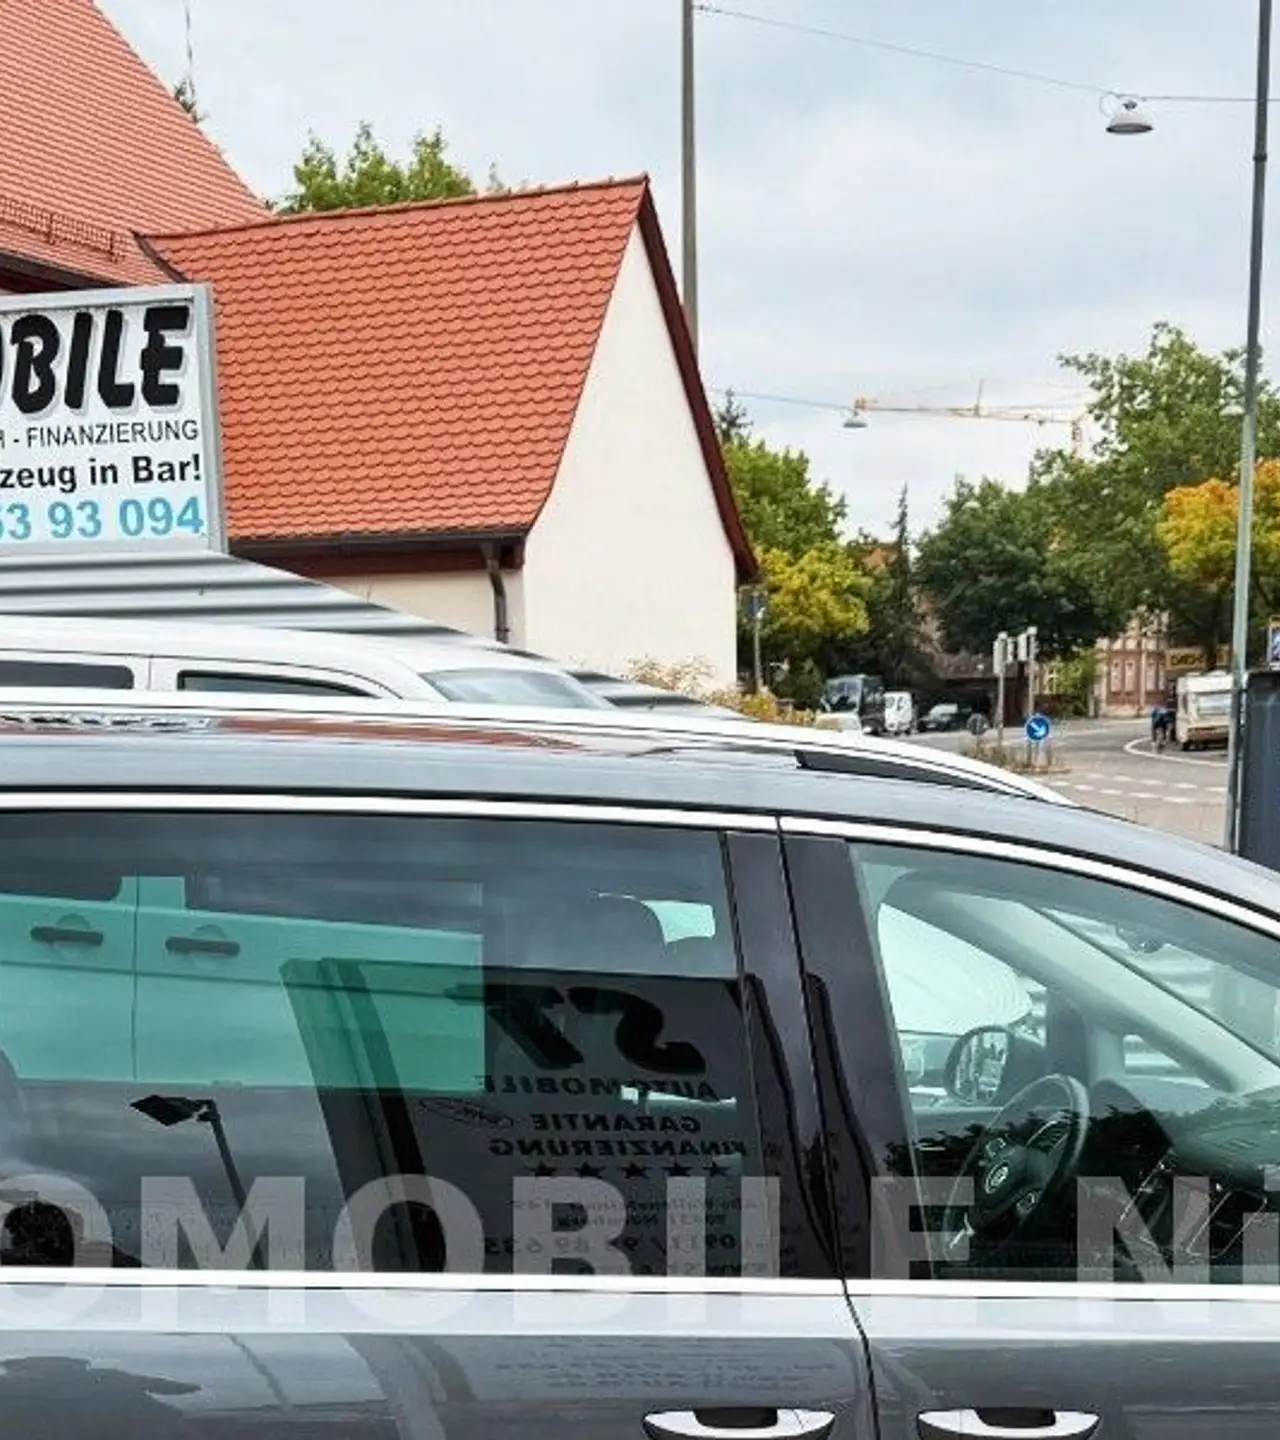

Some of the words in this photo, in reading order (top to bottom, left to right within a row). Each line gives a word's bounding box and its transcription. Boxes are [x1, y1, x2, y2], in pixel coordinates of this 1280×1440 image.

[26, 419, 199, 449] FINANZIERUNG
[89, 459, 121, 485] in
[132, 453, 203, 484] Bar!
[48, 498, 102, 538] 93
[119, 495, 205, 537] 094
